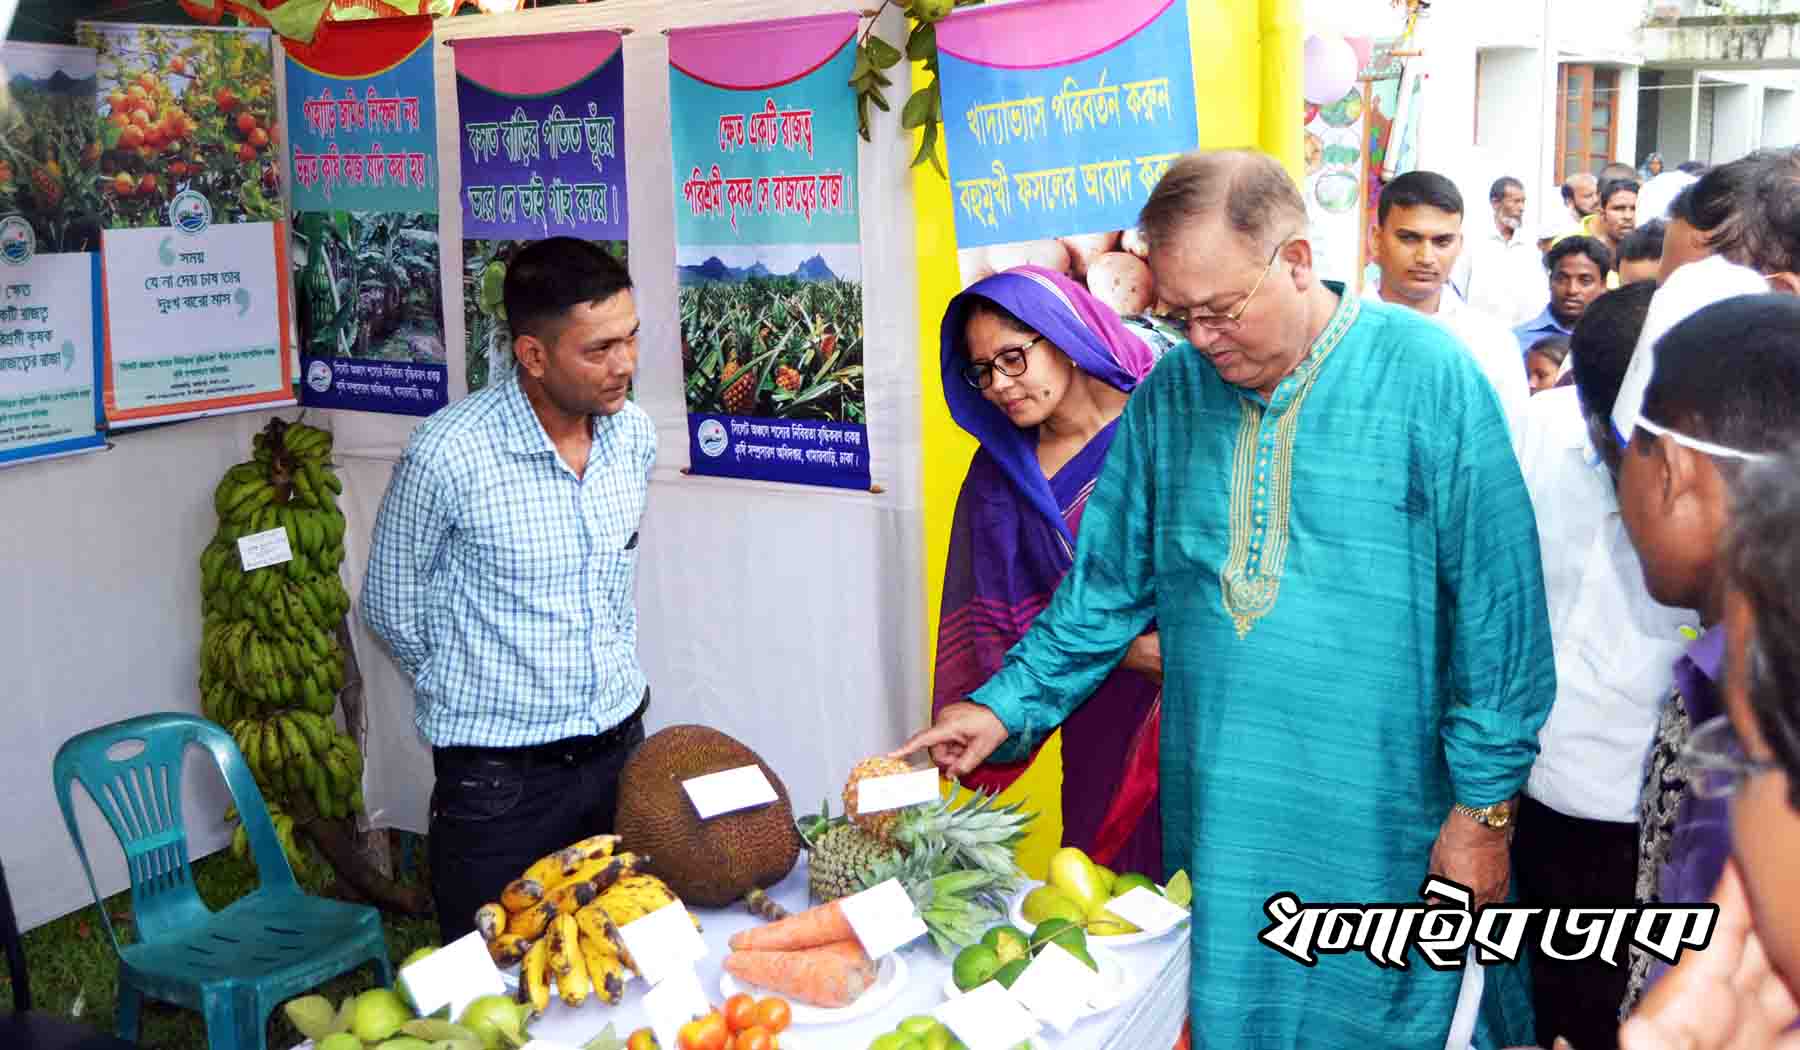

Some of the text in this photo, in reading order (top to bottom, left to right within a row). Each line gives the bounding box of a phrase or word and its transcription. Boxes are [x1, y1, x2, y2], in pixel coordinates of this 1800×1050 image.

[500, 106, 540, 167] বাড়ির
[542, 104, 583, 160] পতিত
[719, 97, 815, 160] ক্ষেত একটি রাজত্ব
[966, 69, 1173, 145] খাদ্যাভ্যাস পরিবর্তন করুন
[320, 144, 340, 202] কৃষি
[341, 153, 364, 184] কাজ
[364, 143, 384, 187] যদি
[385, 152, 408, 187] করা
[684, 163, 724, 216] পরিশ্রমী
[725, 178, 753, 233] কৃষক
[757, 177, 770, 216] সে
[771, 174, 817, 224] রাজত্বের
[818, 173, 844, 214] রাজা
[1014, 167, 1079, 214] ফসলের
[1080, 158, 1134, 206] আবাদ
[468, 186, 496, 223] ভরে
[498, 185, 517, 223] দে
[516, 174, 548, 237] ভাই
[548, 177, 576, 230] গাছ
[179, 251, 205, 264] সময়
